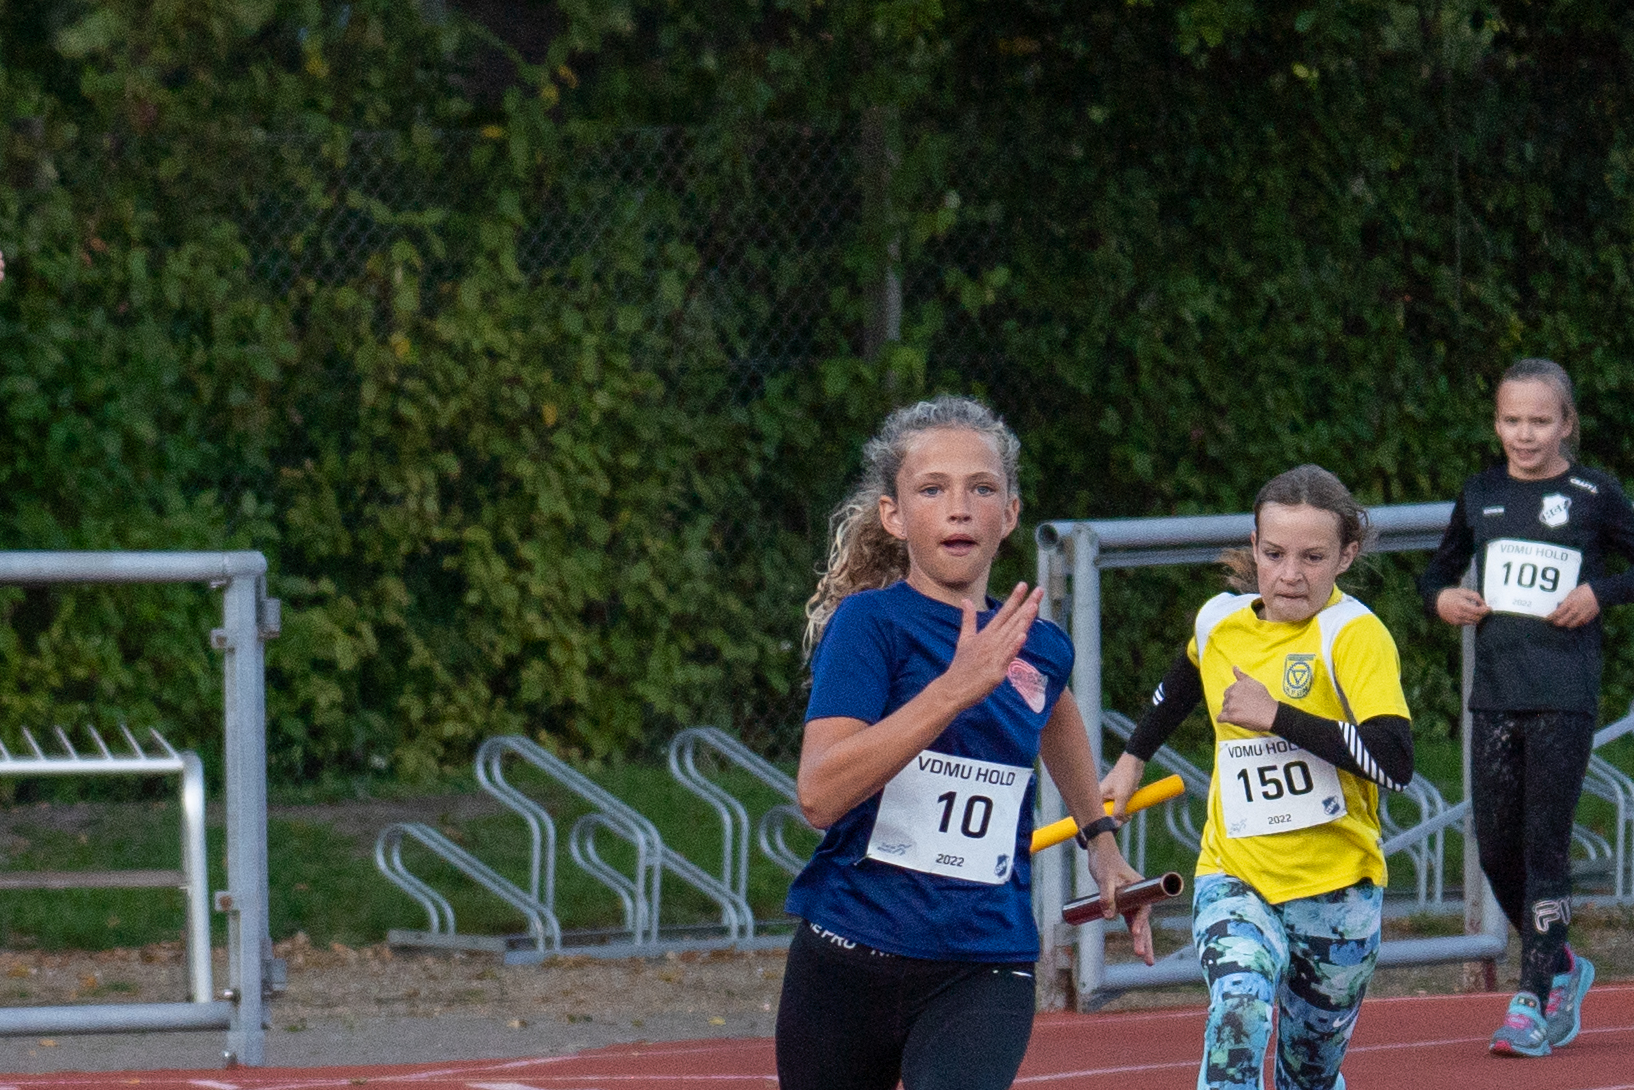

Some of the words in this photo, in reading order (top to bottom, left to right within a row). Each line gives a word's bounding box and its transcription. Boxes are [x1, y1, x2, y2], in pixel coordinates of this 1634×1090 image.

[1500, 544, 1533, 556] VDMU
[1535, 547, 1568, 561] HOLD
[1502, 561, 1561, 592] 109
[1512, 599, 1533, 608] 2022
[1228, 743, 1263, 758] VDMU
[1265, 740, 1298, 755] HOL
[918, 756, 973, 781] VDMU
[975, 767, 1017, 788] HOLD
[1236, 760, 1314, 803] 150
[937, 790, 994, 839] 10
[1268, 814, 1292, 825] 2022
[936, 853, 965, 868] 2022
